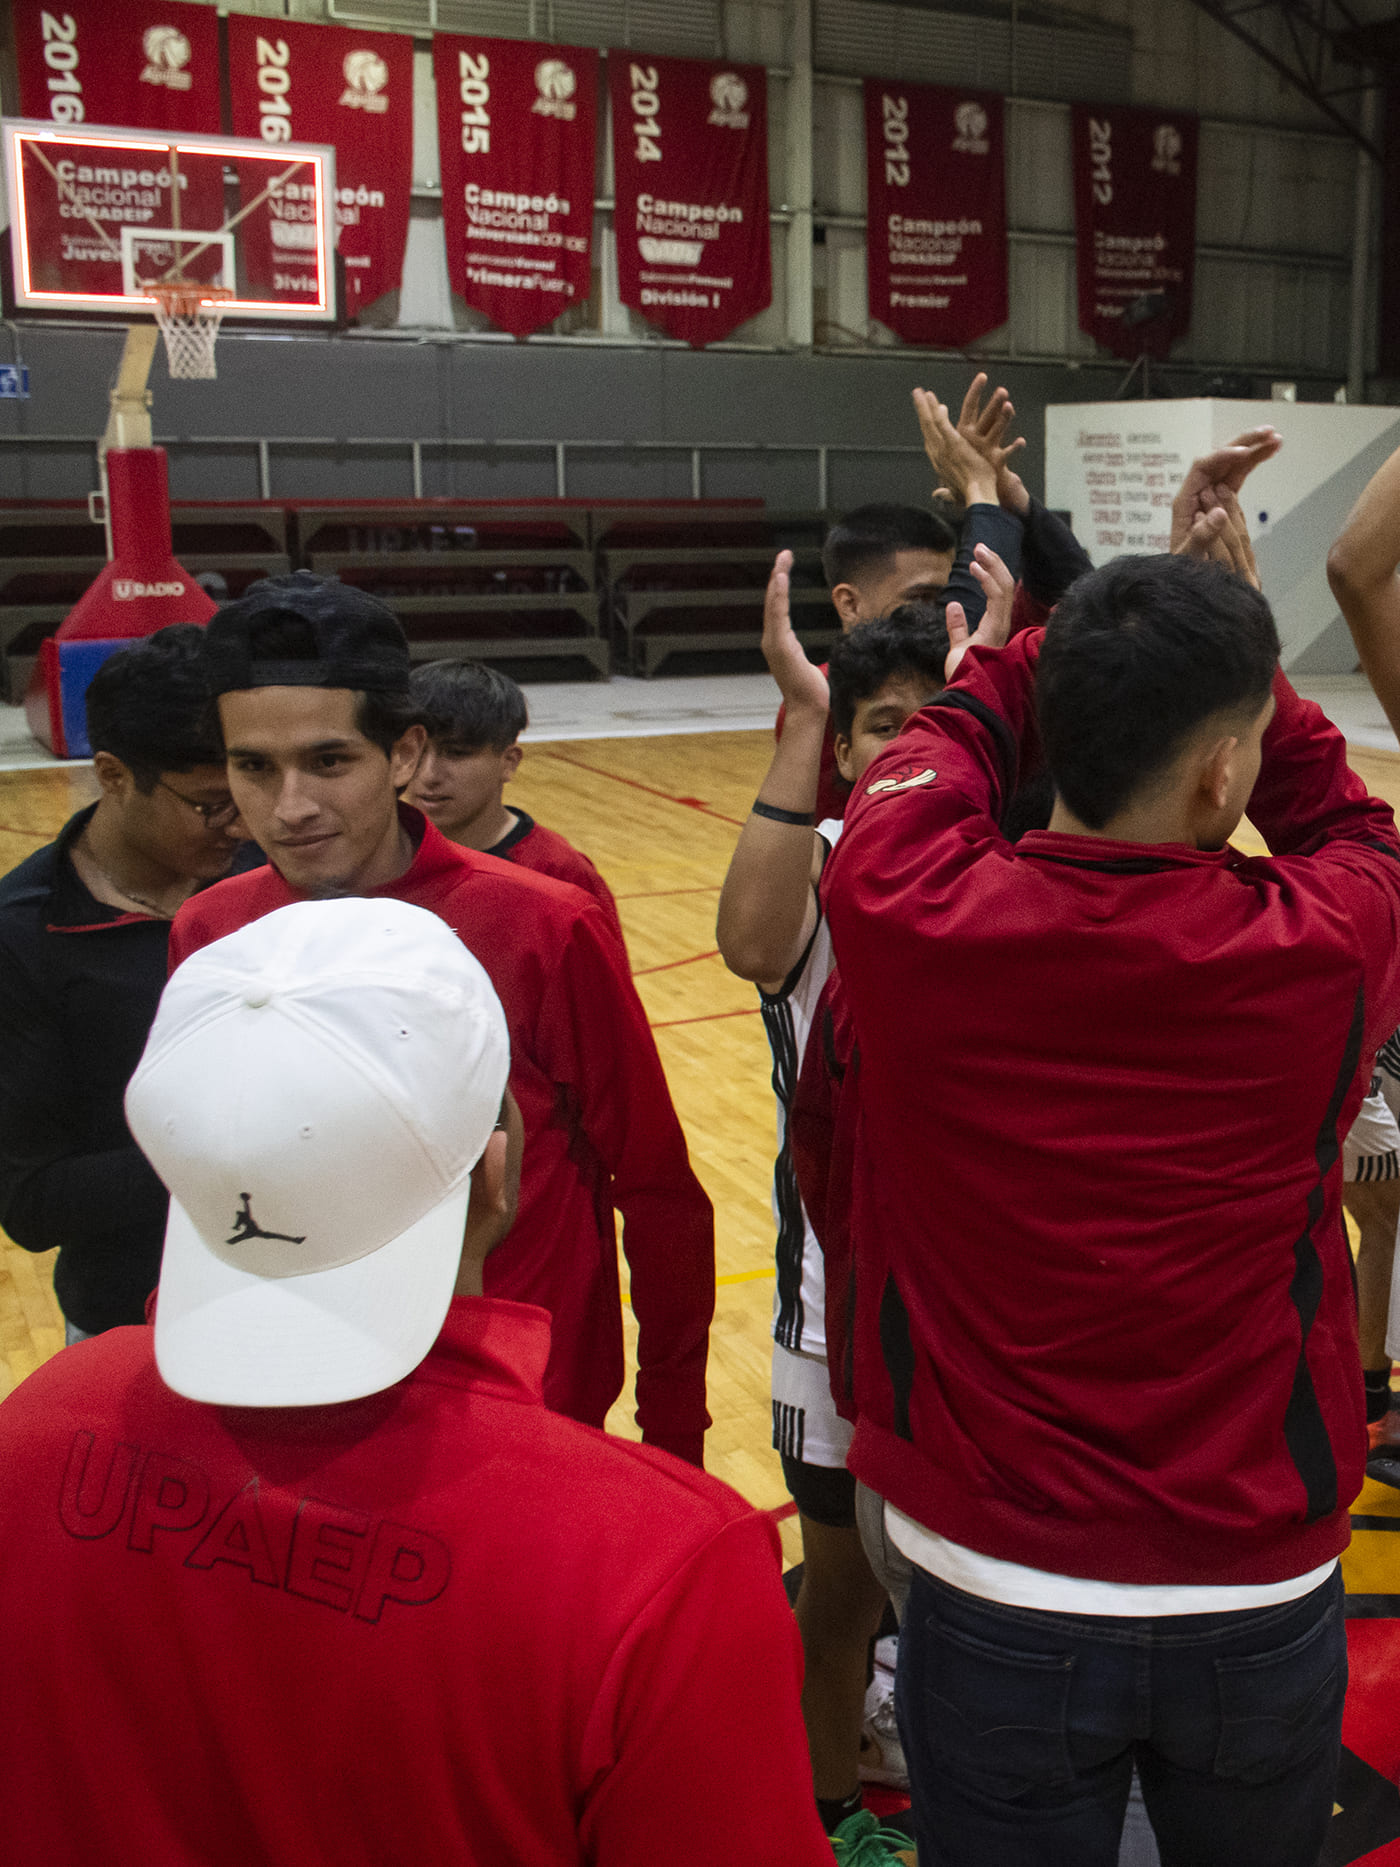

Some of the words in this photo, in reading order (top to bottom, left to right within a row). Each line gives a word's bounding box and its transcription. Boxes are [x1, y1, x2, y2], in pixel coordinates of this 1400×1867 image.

[41, 11, 85, 122] 2016
[256, 36, 292, 143] 2016
[459, 51, 490, 154] 2015
[630, 64, 662, 162] 2014
[883, 94, 909, 186] 2012
[57, 160, 188, 190] Campeón
[1089, 118, 1113, 205] 2012
[58, 182, 161, 207] Nacional
[268, 177, 384, 208] Cameón
[637, 193, 743, 223] Campeón
[636, 212, 720, 240] Nacional
[888, 213, 982, 238] Campeón
[888, 233, 962, 253] Nacional
[133, 581, 185, 597] RADIO
[57, 1428, 453, 1625] UPAEP
